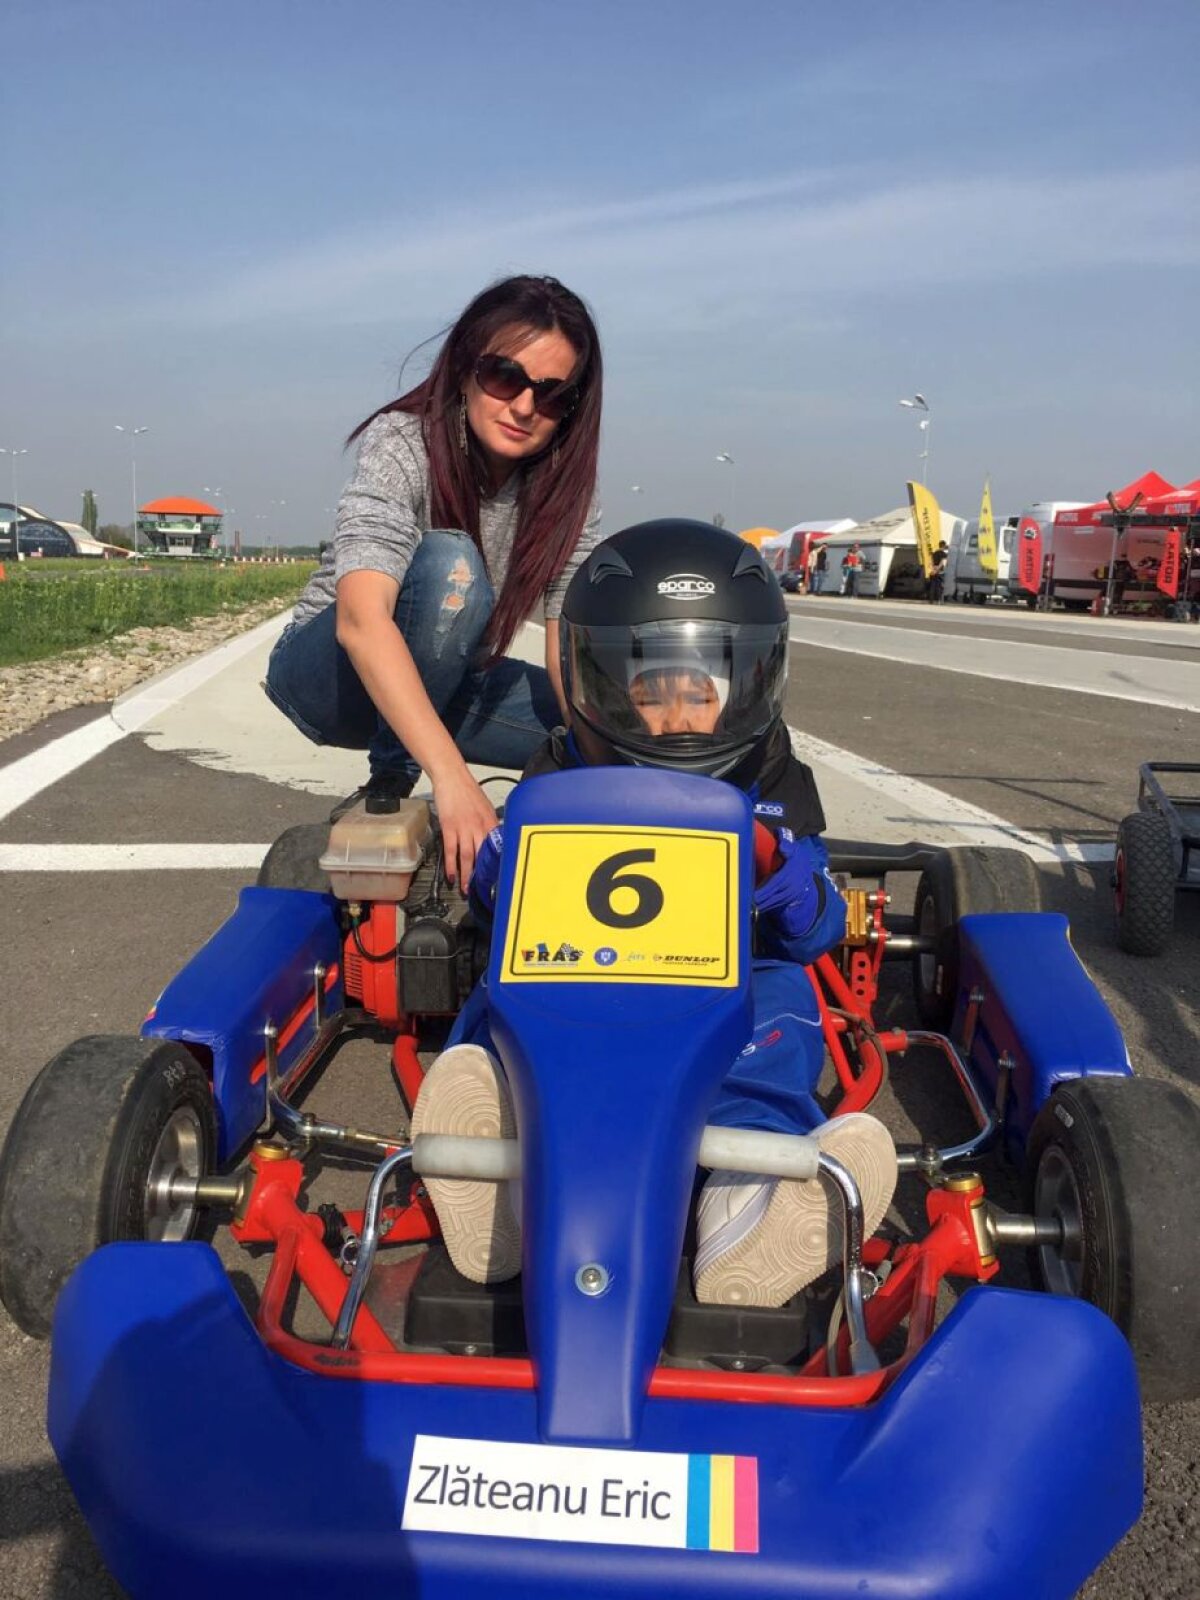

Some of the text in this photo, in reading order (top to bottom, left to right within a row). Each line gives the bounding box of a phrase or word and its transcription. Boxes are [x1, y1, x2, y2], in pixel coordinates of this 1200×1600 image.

[586, 848, 664, 929] 6
[522, 945, 582, 962] FRAS
[664, 954, 720, 963] DUNLOP
[413, 1464, 671, 1521] Zlăteanu Eric
